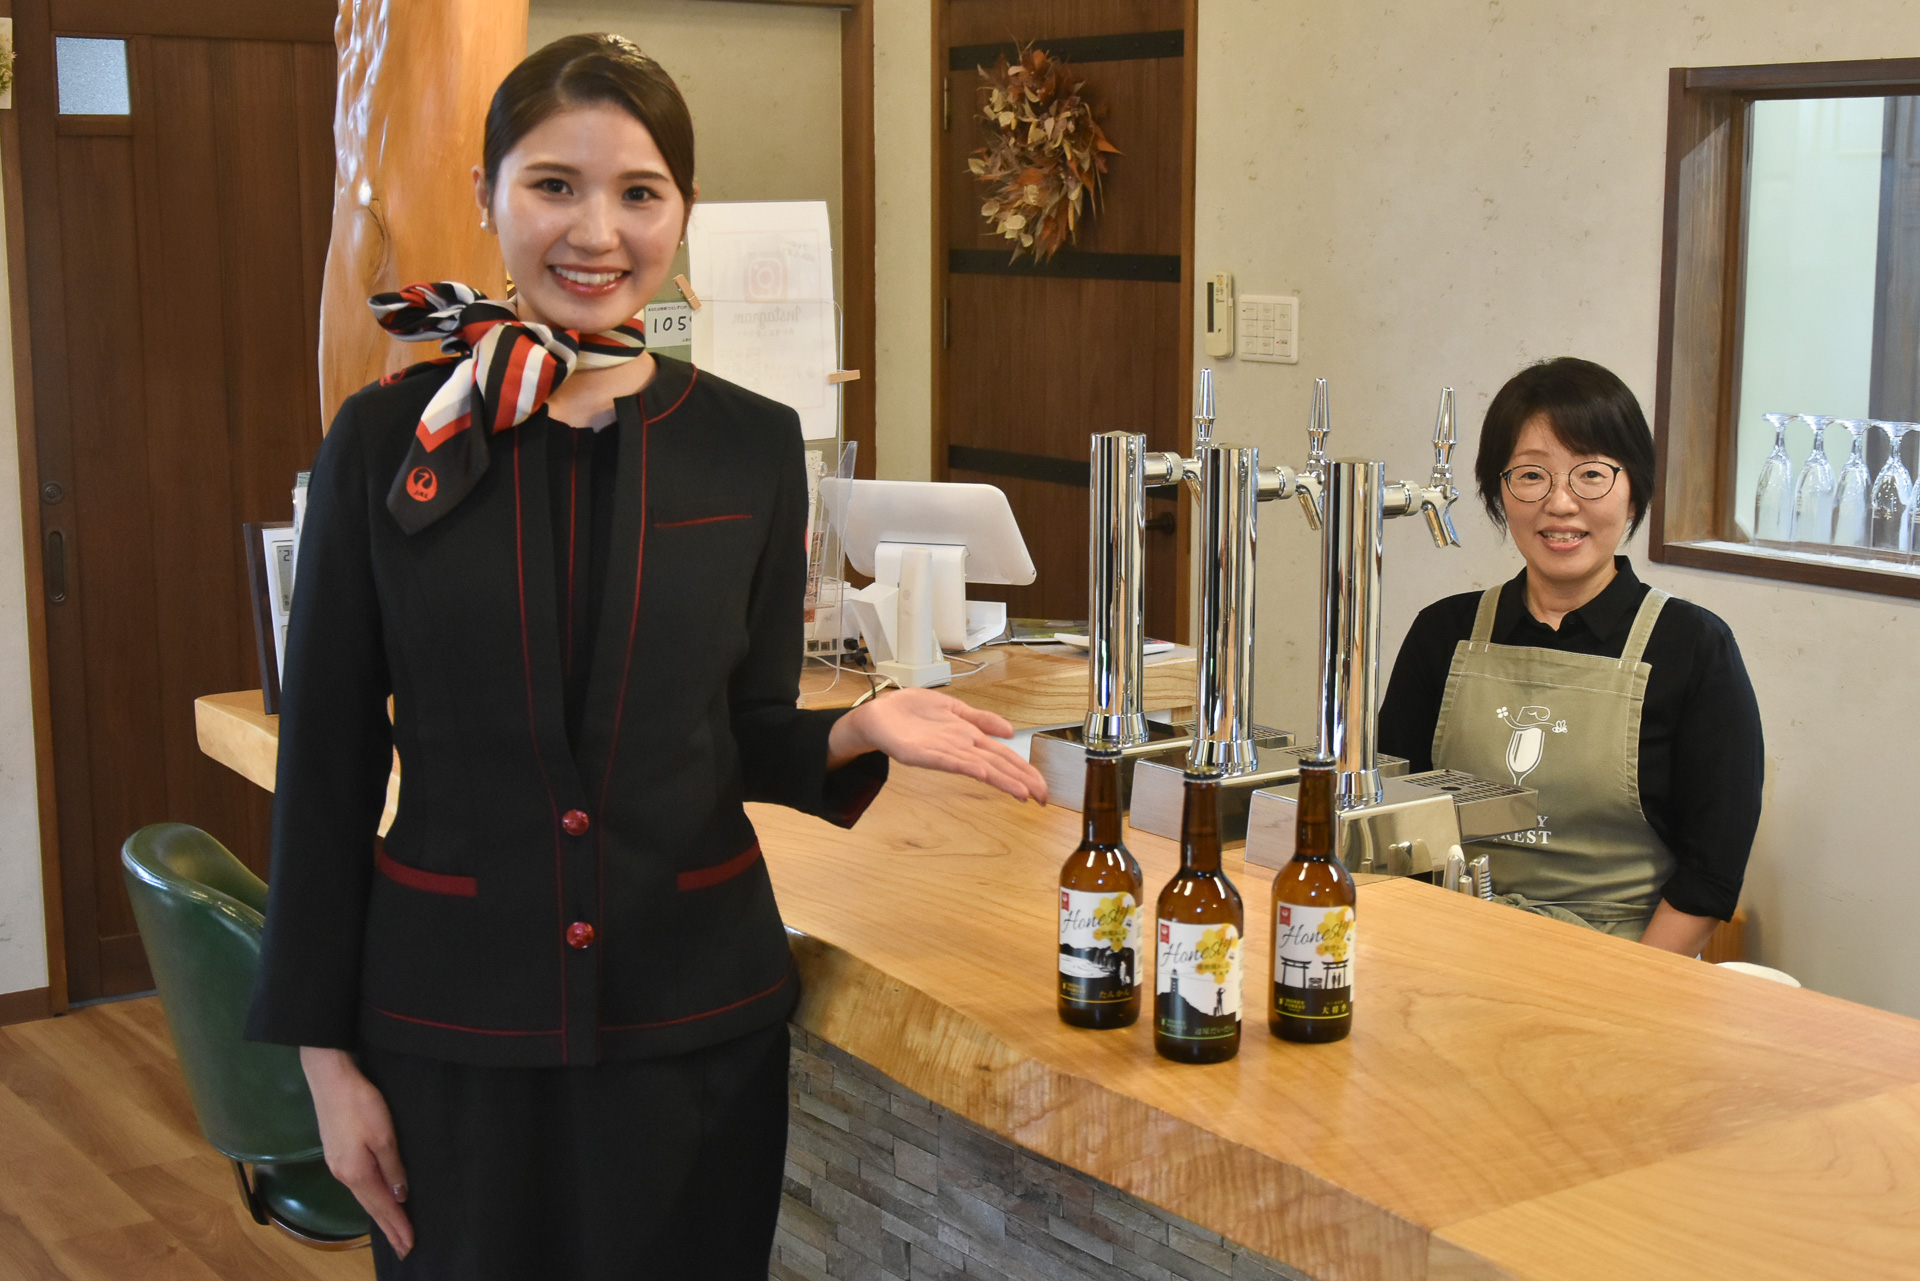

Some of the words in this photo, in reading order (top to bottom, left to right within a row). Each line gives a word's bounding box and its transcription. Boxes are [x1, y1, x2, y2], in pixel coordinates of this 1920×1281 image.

[654, 315, 692, 334] 105
[1061, 904, 1130, 933] Honesty
[1280, 920, 1350, 948] Honesty
[1162, 937, 1233, 966] Honesty
